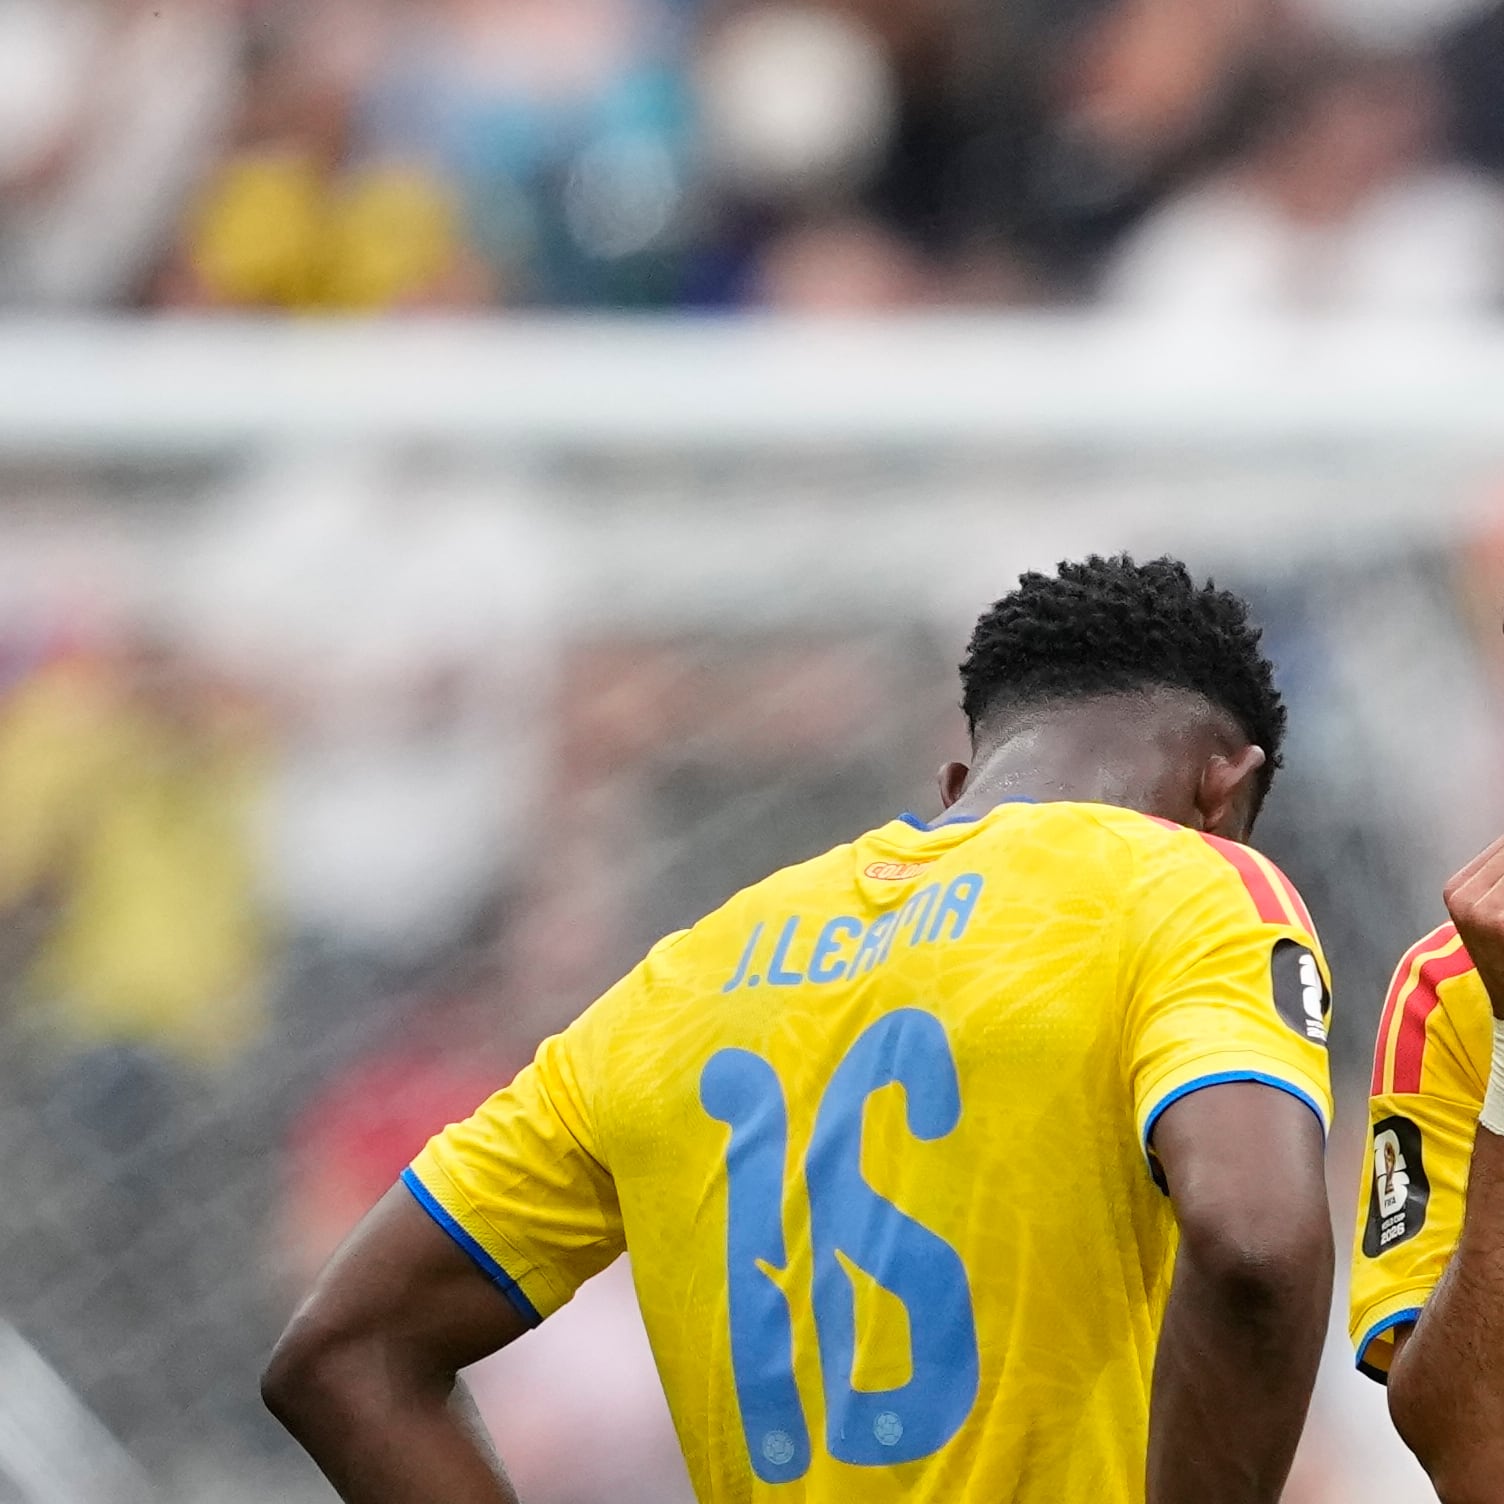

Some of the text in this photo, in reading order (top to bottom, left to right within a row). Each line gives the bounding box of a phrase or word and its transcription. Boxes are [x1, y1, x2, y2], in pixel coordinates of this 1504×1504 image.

[721, 872, 985, 994] J.LERMA
[700, 1006, 981, 1485] 16
[1380, 1222, 1406, 1246] 2026
